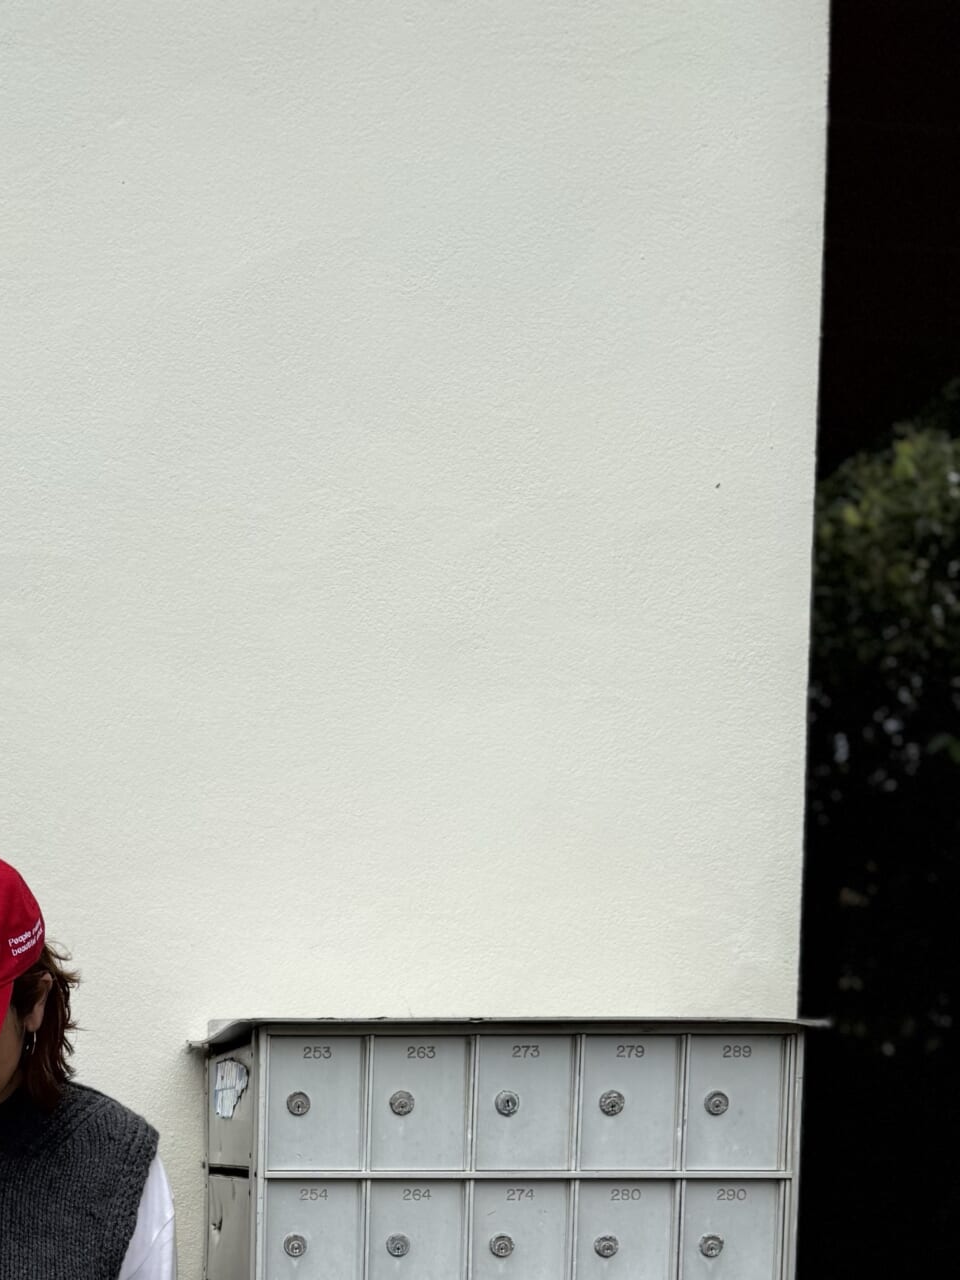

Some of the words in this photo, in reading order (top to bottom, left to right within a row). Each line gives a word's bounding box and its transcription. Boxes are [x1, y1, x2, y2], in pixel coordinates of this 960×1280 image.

[8, 930, 32, 947] People
[303, 1046, 332, 1060] 253
[407, 1046, 436, 1060] 263
[512, 1045, 541, 1059] 273
[616, 1045, 645, 1059] 279
[722, 1045, 752, 1059] 289
[299, 1188, 329, 1202] 254
[402, 1188, 432, 1202] 264
[506, 1188, 536, 1202] 274
[610, 1188, 642, 1202] 280
[716, 1188, 747, 1202] 290
